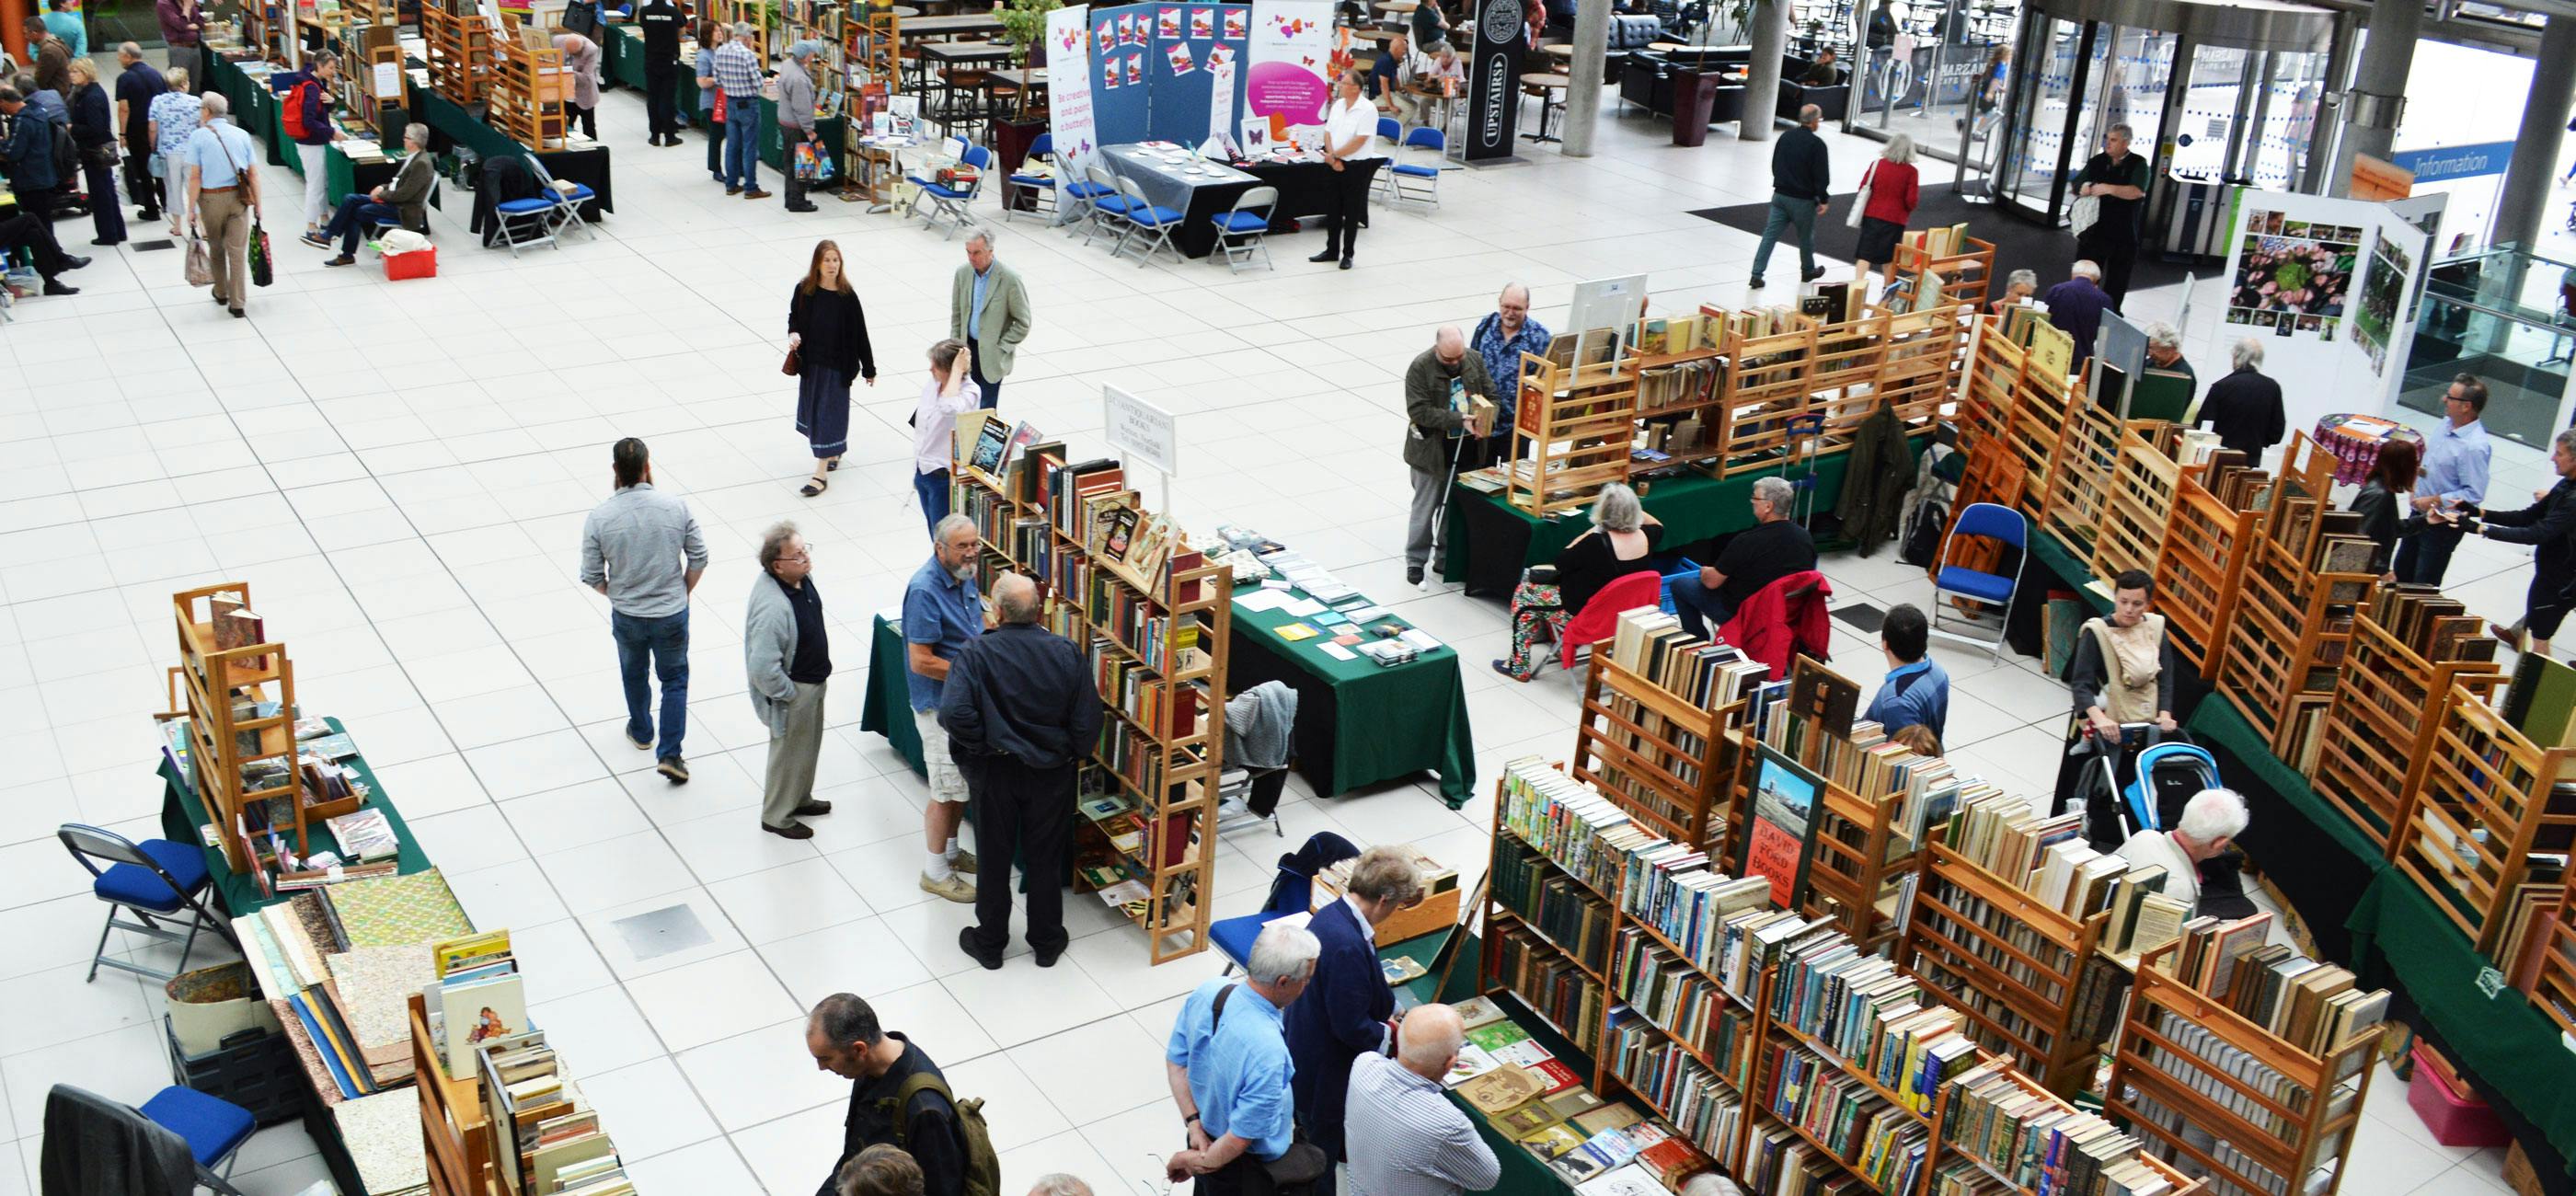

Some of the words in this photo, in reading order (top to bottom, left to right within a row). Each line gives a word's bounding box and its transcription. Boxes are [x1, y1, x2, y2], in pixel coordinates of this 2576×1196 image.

[1066, 89, 1090, 100] creative
[1487, 69, 1503, 137] UPSTAIRS
[1061, 107, 1073, 117] and
[1074, 103, 1089, 115] paint
[1065, 116, 1092, 131] butterfly
[2414, 151, 2488, 178] Information
[1759, 824, 1794, 855] DAVID
[1759, 842, 1788, 869] FORD
[1753, 856, 1789, 888] BOOKS
